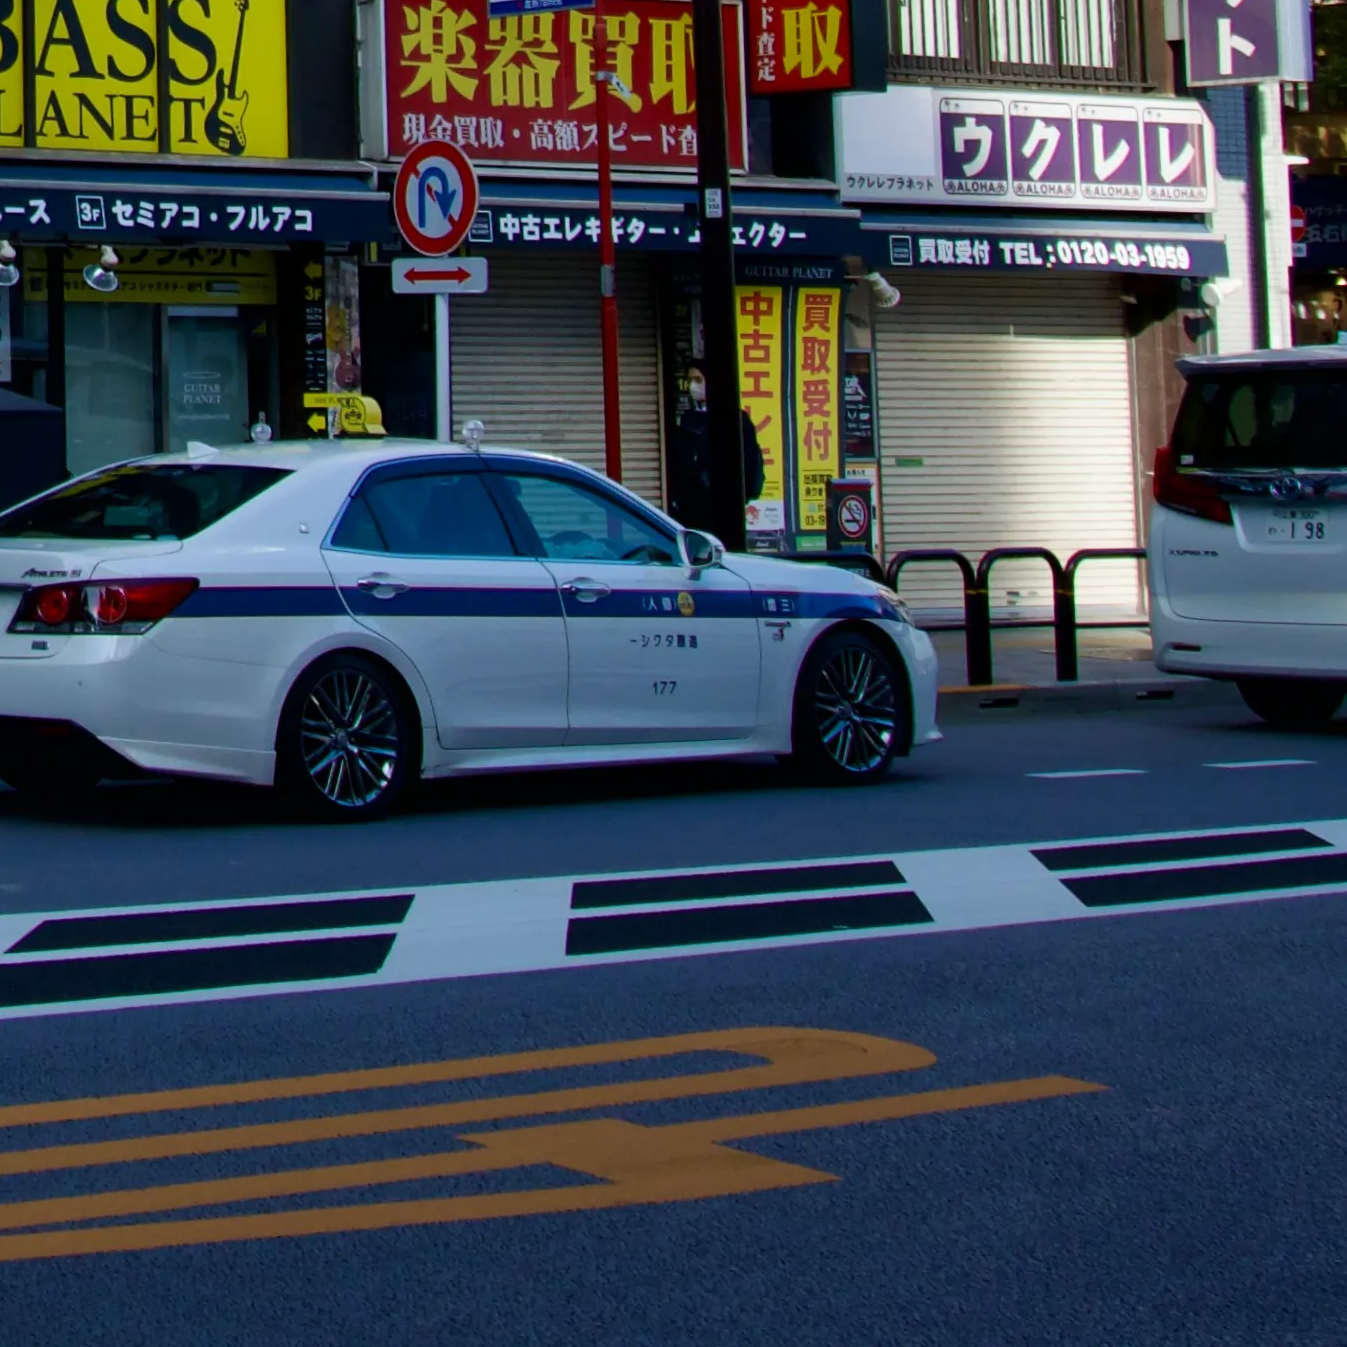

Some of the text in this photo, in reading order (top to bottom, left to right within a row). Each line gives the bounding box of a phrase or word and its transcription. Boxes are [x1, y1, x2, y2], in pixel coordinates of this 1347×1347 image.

[953, 116, 1196, 184] ウクレレ
[845, 172, 936, 194] ウクレレプラネット
[956, 180, 997, 195] ALOHA
[1025, 182, 1064, 197] ALOHA
[1092, 184, 1132, 199] ALOHA
[1159, 187, 1195, 201] ALOHA
[80, 201, 101, 223] 3F
[111, 200, 313, 233] セミアコ・フルアコ
[500, 211, 807, 248] 中古エレキギター・ェクター
[918, 238, 990, 266] 買取受付
[745, 265, 834, 280] GUITAR PLANET
[802, 293, 833, 462] 買取受付
[183, 383, 221, 394] GUITAR
[183, 394, 222, 405] PLANET
[652, 680, 678, 695] 177
